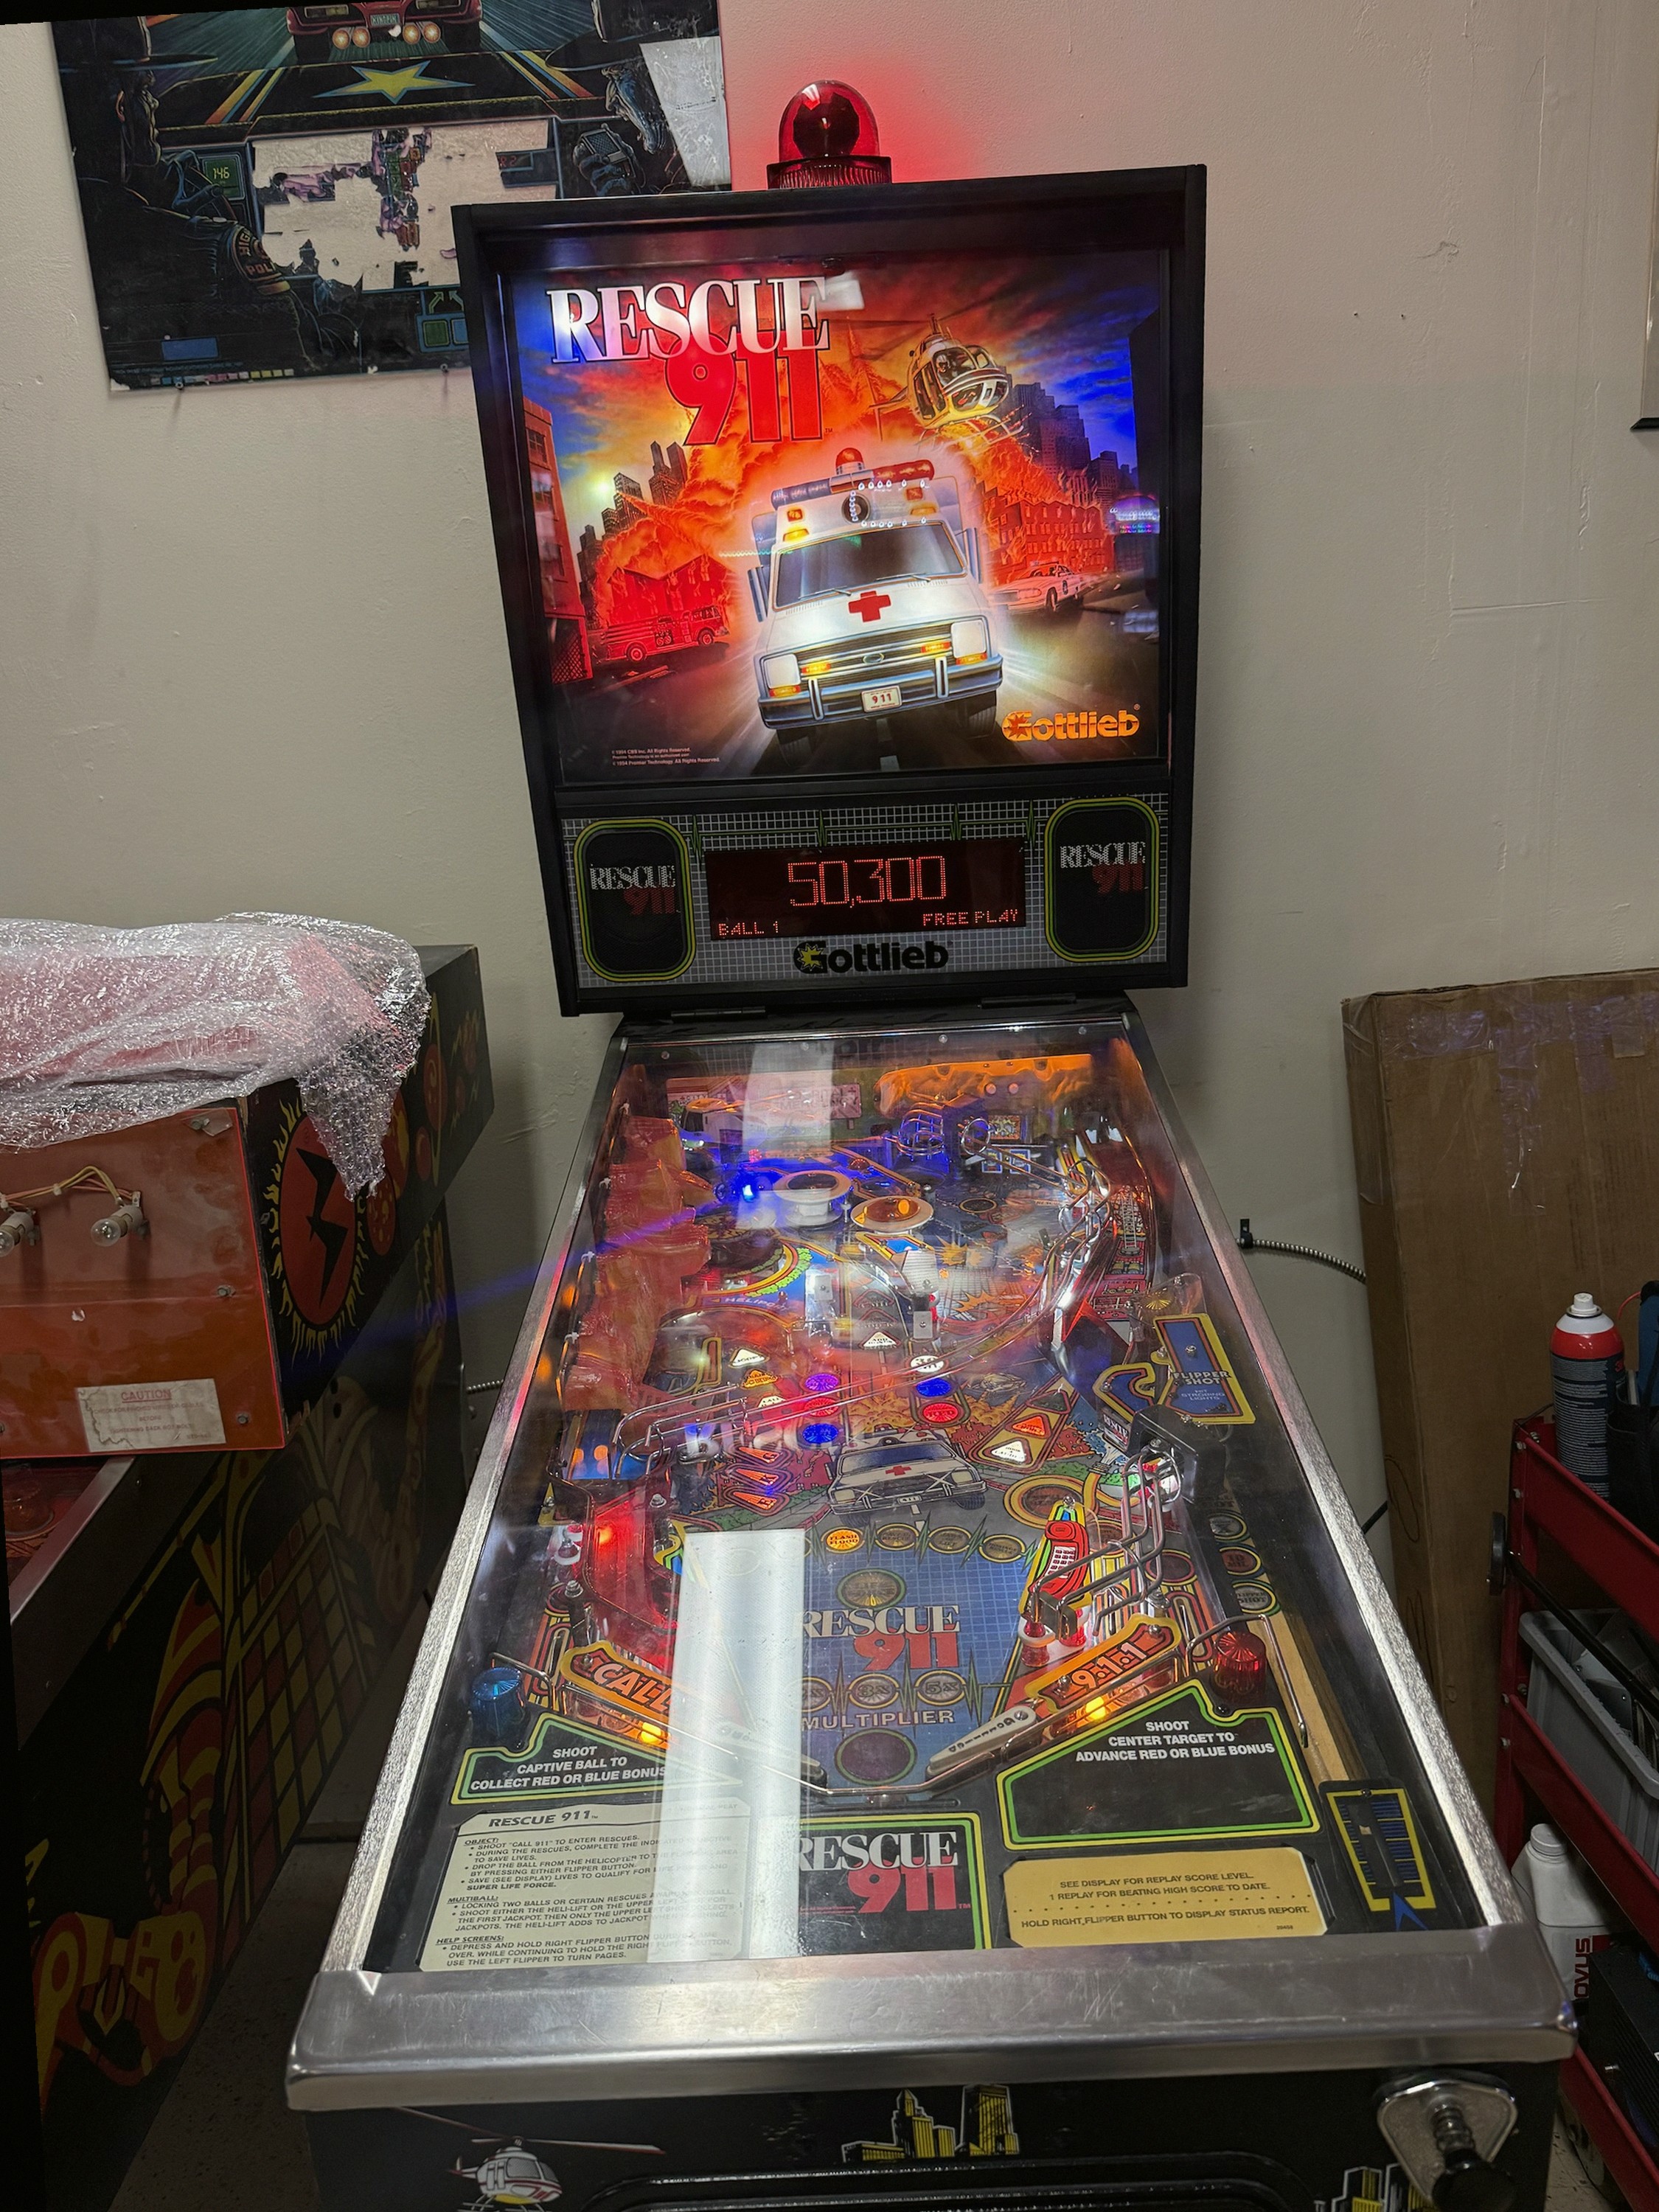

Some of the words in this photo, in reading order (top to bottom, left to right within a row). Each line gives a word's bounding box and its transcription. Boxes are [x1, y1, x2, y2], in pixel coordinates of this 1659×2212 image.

[213, 167, 230, 179] 146
[546, 276, 831, 364] RESCUE
[665, 330, 823, 446] 911
[872, 693, 891, 703] 911
[1002, 709, 1140, 742] Gottlieb
[1060, 841, 1146, 869] RESCUE
[590, 864, 676, 890] RESCUE
[787, 855, 947, 908] 50,300
[1092, 858, 1144, 895] 911
[623, 883, 675, 915] 911
[922, 911, 969, 927] FREE
[974, 908, 1018, 924] PLAY
[718, 921, 765, 936] BALL
[772, 920, 779, 933] 1
[793, 939, 950, 975] Gottlieb
[1173, 1371, 1230, 1380] FLIPPER
[1185, 1377, 1221, 1385] SHOT
[120, 1389, 172, 1402] CAUTION
[802, 1604, 961, 1638] RESCUE
[853, 1624, 959, 1672] 911
[594, 1663, 672, 1712] CALL
[802, 1710, 956, 1731] MULTIPLIER
[1145, 1721, 1190, 1732] SHOOT
[1108, 1736, 1161, 1747] CENTER
[1163, 1733, 1214, 1745] TARGET
[1216, 1732, 1235, 1742] TO
[553, 1746, 597, 1759] SHOOT
[1075, 1750, 1138, 1762] ADVANCE
[1139, 1748, 1168, 1760] RED
[1170, 1747, 1189, 1759] OR
[1192, 1745, 1227, 1758] BLUE
[1229, 1743, 1276, 1756] BONUS
[517, 1761, 573, 1775] CAPTIVE
[575, 1758, 608, 1770] BALL
[611, 1756, 627, 1767] TO
[470, 1777, 530, 1791] COLLECT
[532, 1775, 560, 1787] RED
[563, 1773, 582, 1784] OR
[585, 1770, 620, 1783] BLUE
[622, 1767, 666, 1779] BONUS
[488, 1814, 556, 1828] RESCUE
[561, 1810, 591, 1820] 911
[465, 1837, 499, 1846] OBJECT:
[478, 1843, 506, 1851] SHOOT
[599, 1834, 640, 1843] RESCUES.
[574, 1843, 619, 1851] COMPLETE
[585, 1855, 637, 1865] HELICOPTER
[799, 1832, 958, 1871] RESCUE
[601, 1863, 636, 1871] BUTTON.
[515, 1874, 552, 1882] DISPLAY)
[594, 1870, 630, 1879] QUALIFY
[1081, 1879, 1121, 1887] DISPLAY
[1146, 1875, 1182, 1884] REPLAY
[847, 1857, 956, 1913] 911
[1057, 1891, 1093, 1899] REPLAY
[1119, 1888, 1161, 1896] BEATING
[1164, 1886, 1188, 1894] HIGH
[1190, 1885, 1225, 1893] SCORE
[1242, 1882, 1270, 1891] DATE.
[447, 1895, 499, 1904] MULTIBALL:
[568, 1896, 605, 1905] CERTAIN
[608, 1893, 647, 1902] RESCUES
[456, 1923, 502, 1931] JACKPOTS.
[609, 1915, 647, 1924] JACKPOT
[1021, 1919, 1049, 1927] HOLD
[1085, 1915, 1124, 1924] FLIPPER
[1127, 1913, 1167, 1921] BUTTON
[1186, 1910, 1226, 1918] DISPLAY
[1229, 1907, 1266, 1916] STATUS
[1268, 1905, 1310, 1914] REPORT.
[436, 1937, 460, 1945] HELP
[614, 1934, 650, 1943] BUTTON
[595, 1951, 627, 1959] PAGES.
[1574, 1938, 1590, 1998] OVUS
